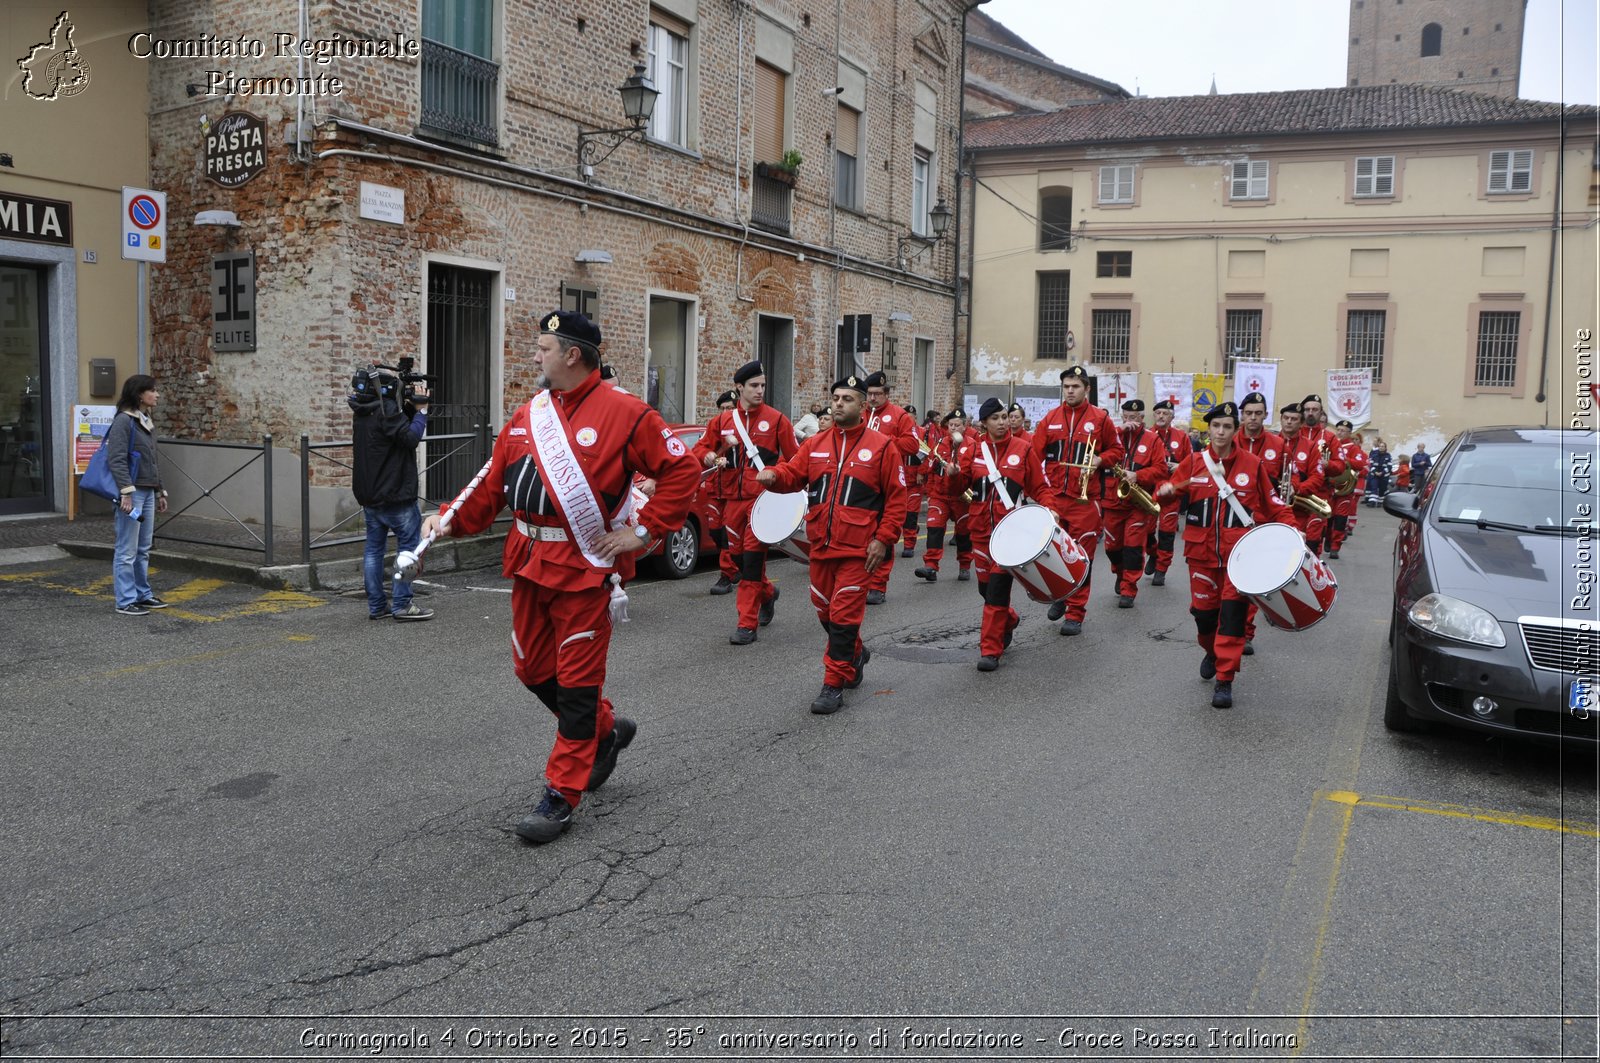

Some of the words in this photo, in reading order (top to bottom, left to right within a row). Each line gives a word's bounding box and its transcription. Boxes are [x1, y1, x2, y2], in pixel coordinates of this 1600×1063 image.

[207, 127, 263, 155] PASTA
[207, 149, 264, 175] FRESCA
[220, 175, 233, 184] DAL
[85, 251, 95, 261] 15
[215, 331, 250, 344] ELITE
[536, 415, 562, 456] CROCE
[547, 449, 581, 497] ROSSA
